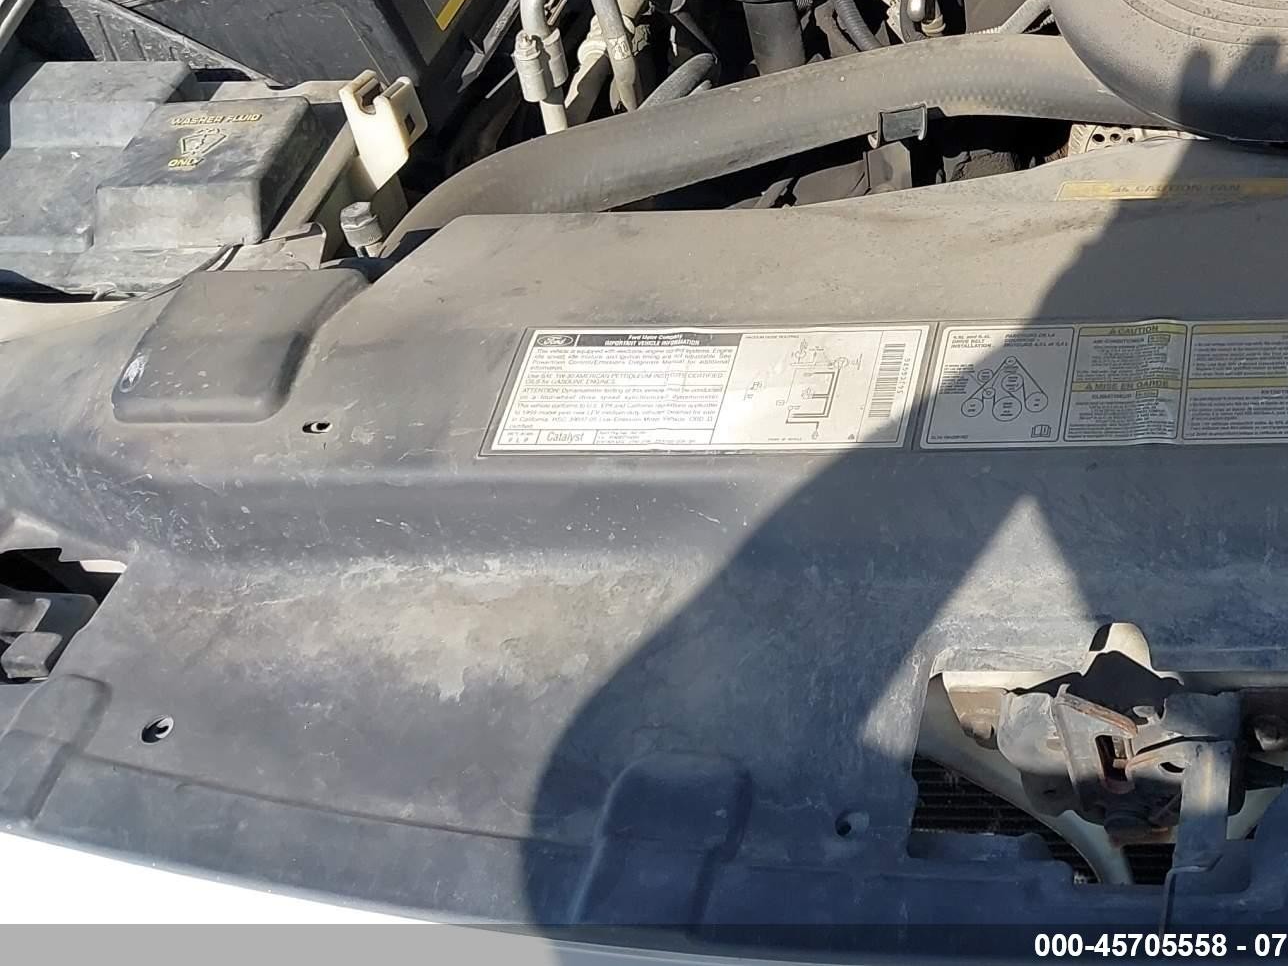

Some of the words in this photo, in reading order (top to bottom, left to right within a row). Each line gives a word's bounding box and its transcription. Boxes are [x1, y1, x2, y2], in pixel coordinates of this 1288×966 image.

[171, 115, 225, 126] WASHER
[225, 114, 263, 123] FLUID
[1118, 325, 1158, 335] CAUTION
[544, 337, 566, 345] Ford
[546, 432, 584, 443] Catalyst
